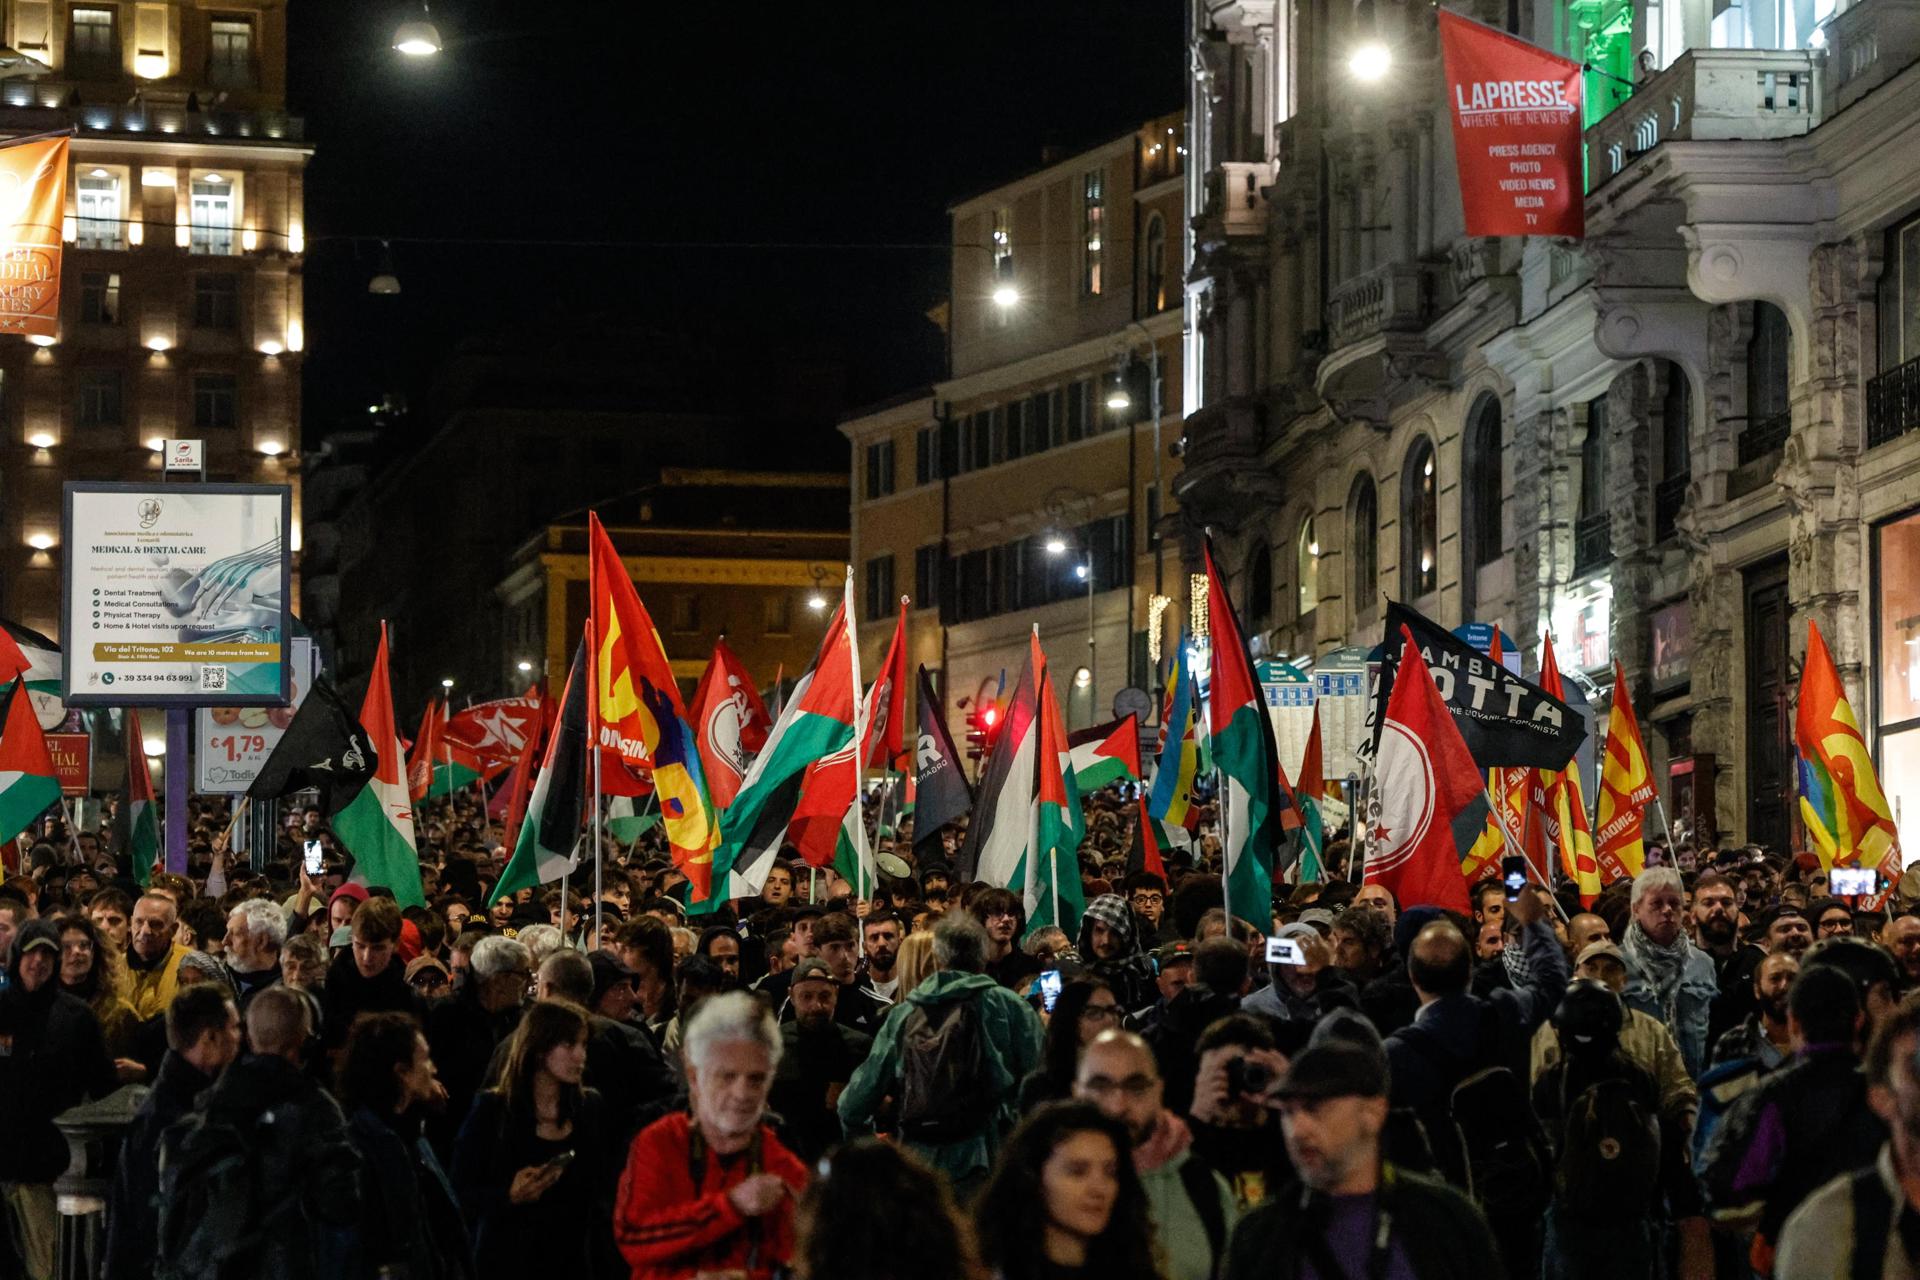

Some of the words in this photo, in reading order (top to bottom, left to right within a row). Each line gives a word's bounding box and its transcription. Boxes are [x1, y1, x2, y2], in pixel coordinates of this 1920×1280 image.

[1456, 80, 1569, 111] LAPRESSE
[1459, 113, 1499, 128] WHERE
[1503, 112, 1523, 126] THE
[1526, 111, 1557, 125] NEWS
[1560, 111, 1570, 125] IS
[1488, 145, 1519, 157] PRESS
[1521, 144, 1556, 156] AGENCY
[1510, 162, 1541, 173] PHOTO
[1499, 180, 1527, 191] VIDEO
[1529, 178, 1556, 190] NEWS
[1515, 196, 1544, 208] MEDIA
[1526, 213, 1538, 225] TV
[91, 546, 132, 554] MEDICAL
[134, 546, 141, 554] &
[143, 546, 180, 554] DENTAL
[181, 546, 206, 555] CARE
[118, 645, 131, 653] del
[132, 646, 160, 654] Tritone,
[1400, 644, 1518, 685] AMBI
[1394, 664, 1562, 728] OTTA
[229, 769, 256, 779] Todis
